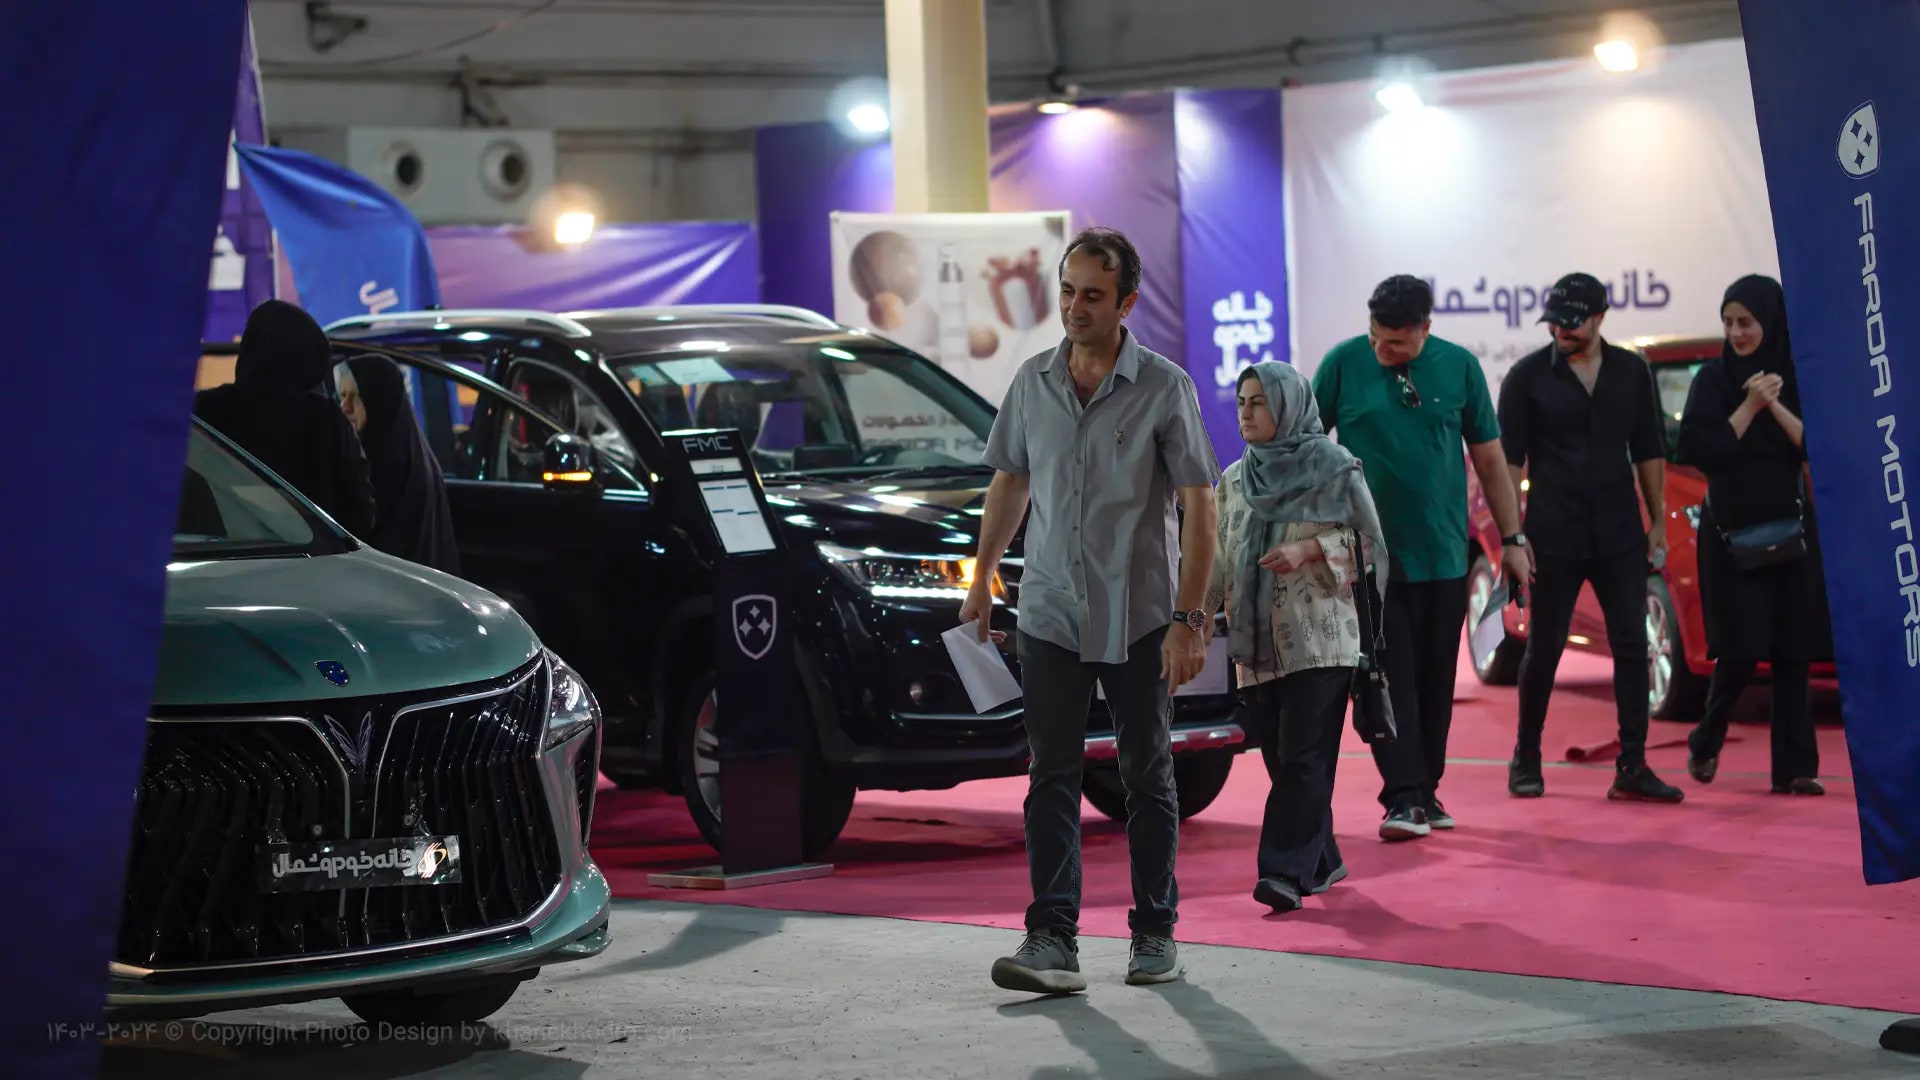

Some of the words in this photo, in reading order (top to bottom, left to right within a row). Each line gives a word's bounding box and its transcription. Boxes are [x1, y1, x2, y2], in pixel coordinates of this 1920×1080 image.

[1854, 192, 1892, 397] FARDA
[1876, 414, 1920, 668] MOTORS
[682, 436, 733, 453] FMC
[272, 853, 320, 878] شمال
